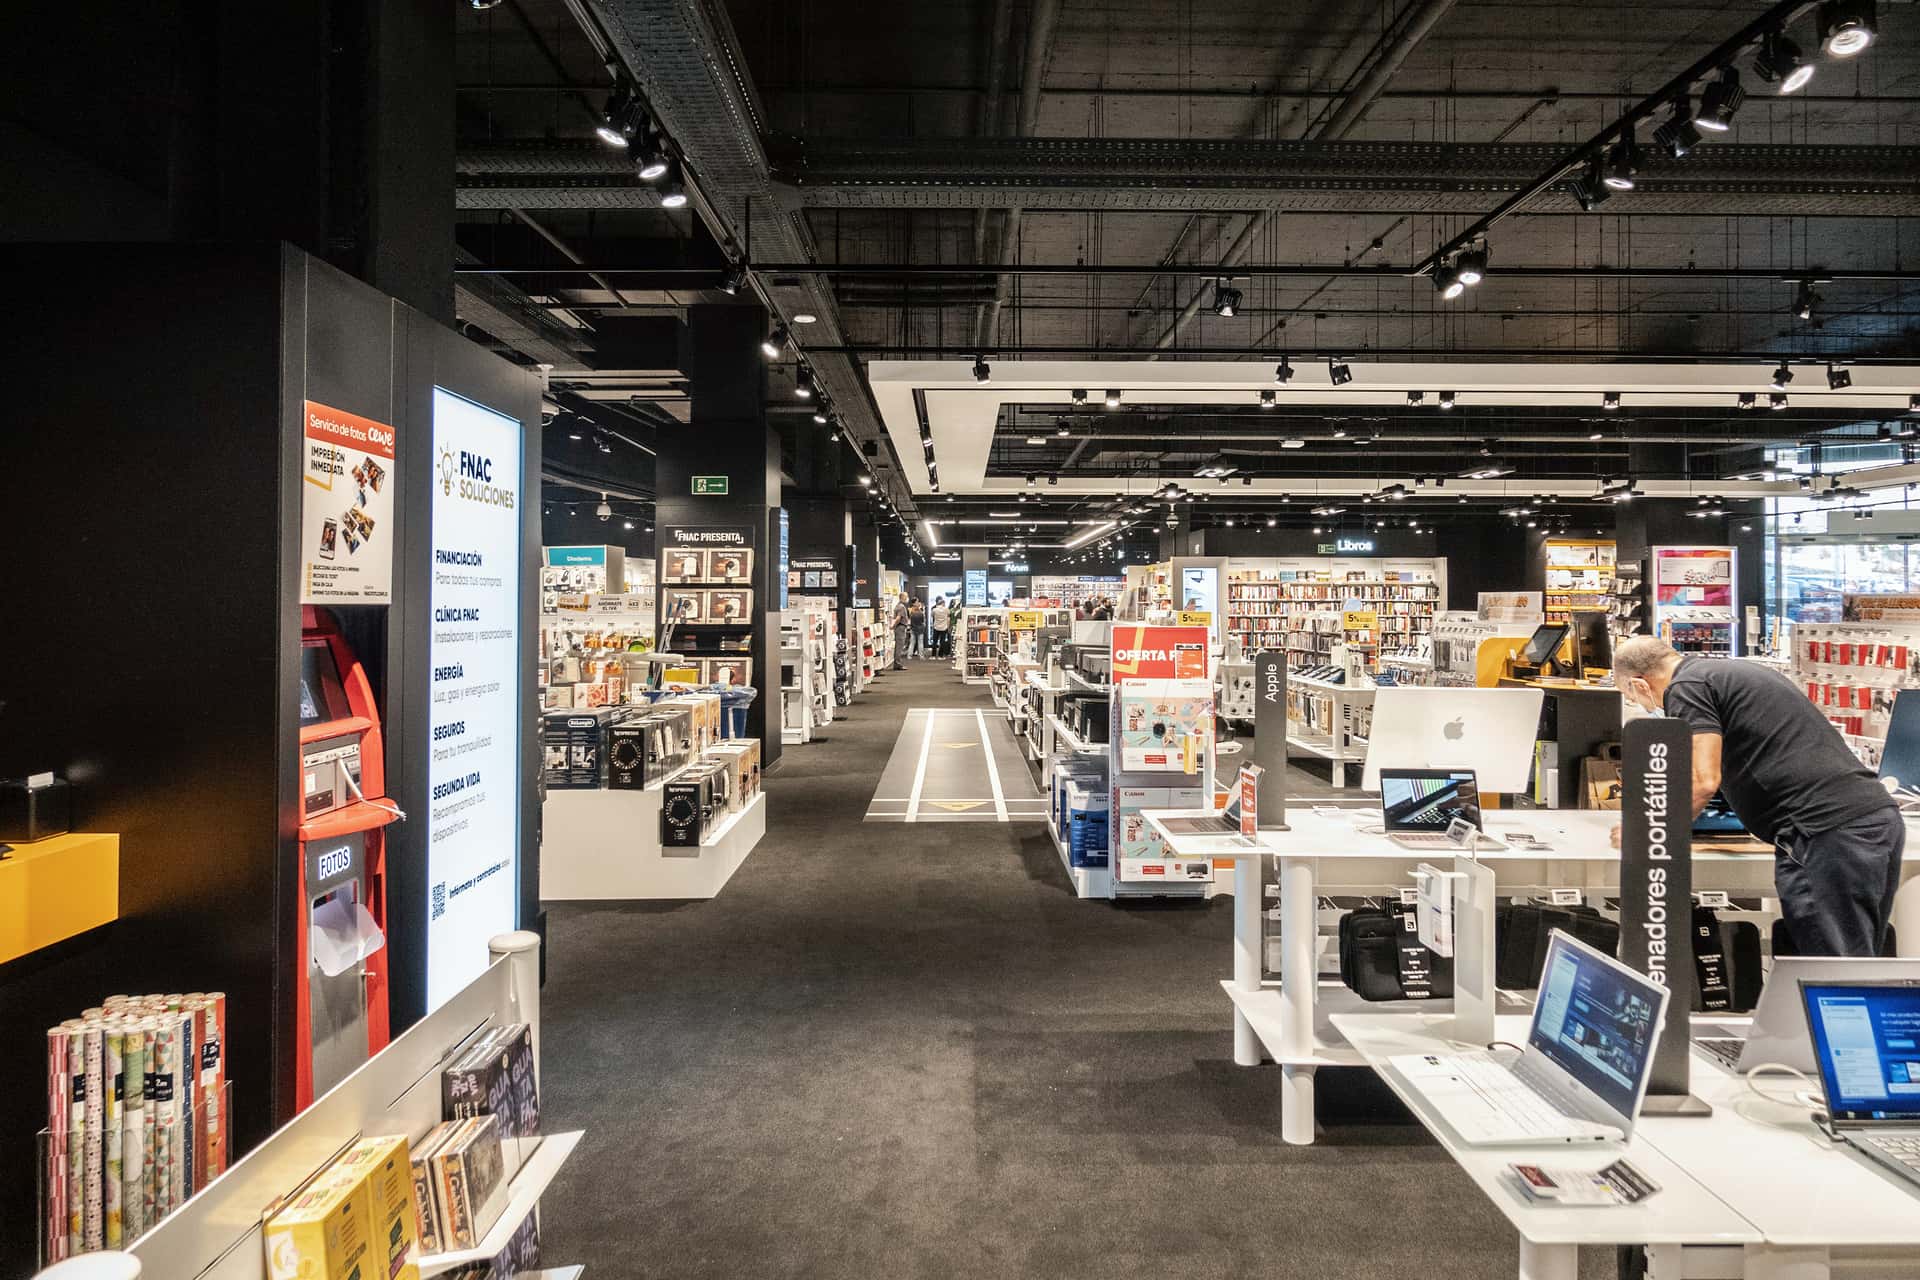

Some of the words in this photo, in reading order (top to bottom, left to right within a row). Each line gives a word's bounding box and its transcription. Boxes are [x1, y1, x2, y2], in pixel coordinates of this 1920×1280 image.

[310, 413, 340, 434] Servicio
[339, 423, 350, 437] de
[350, 425, 367, 442] fotos
[311, 445, 345, 464] IMPRESIÓN
[311, 459, 345, 477] INMEDIATA
[460, 450, 492, 483] FNAC
[459, 478, 514, 509] SOLUCIONES
[678, 532, 700, 542] FNAC
[700, 532, 741, 542] PRESENTA
[1337, 539, 1373, 551] Libros
[436, 549, 482, 567] FINANCIACIÓN
[435, 571, 451, 585] Para
[435, 604, 462, 622] CLÍNICA
[463, 608, 480, 621] FNAC
[1115, 649, 1166, 661] OFERTA
[434, 661, 464, 682] ENERGÍA
[1264, 662, 1278, 702] Apple
[433, 720, 465, 741] SEGUROS
[433, 776, 465, 801] SEGUNDA
[465, 771, 481, 788] VIDA
[1642, 742, 1673, 861] portátiles
[321, 848, 349, 877] FOTOS
